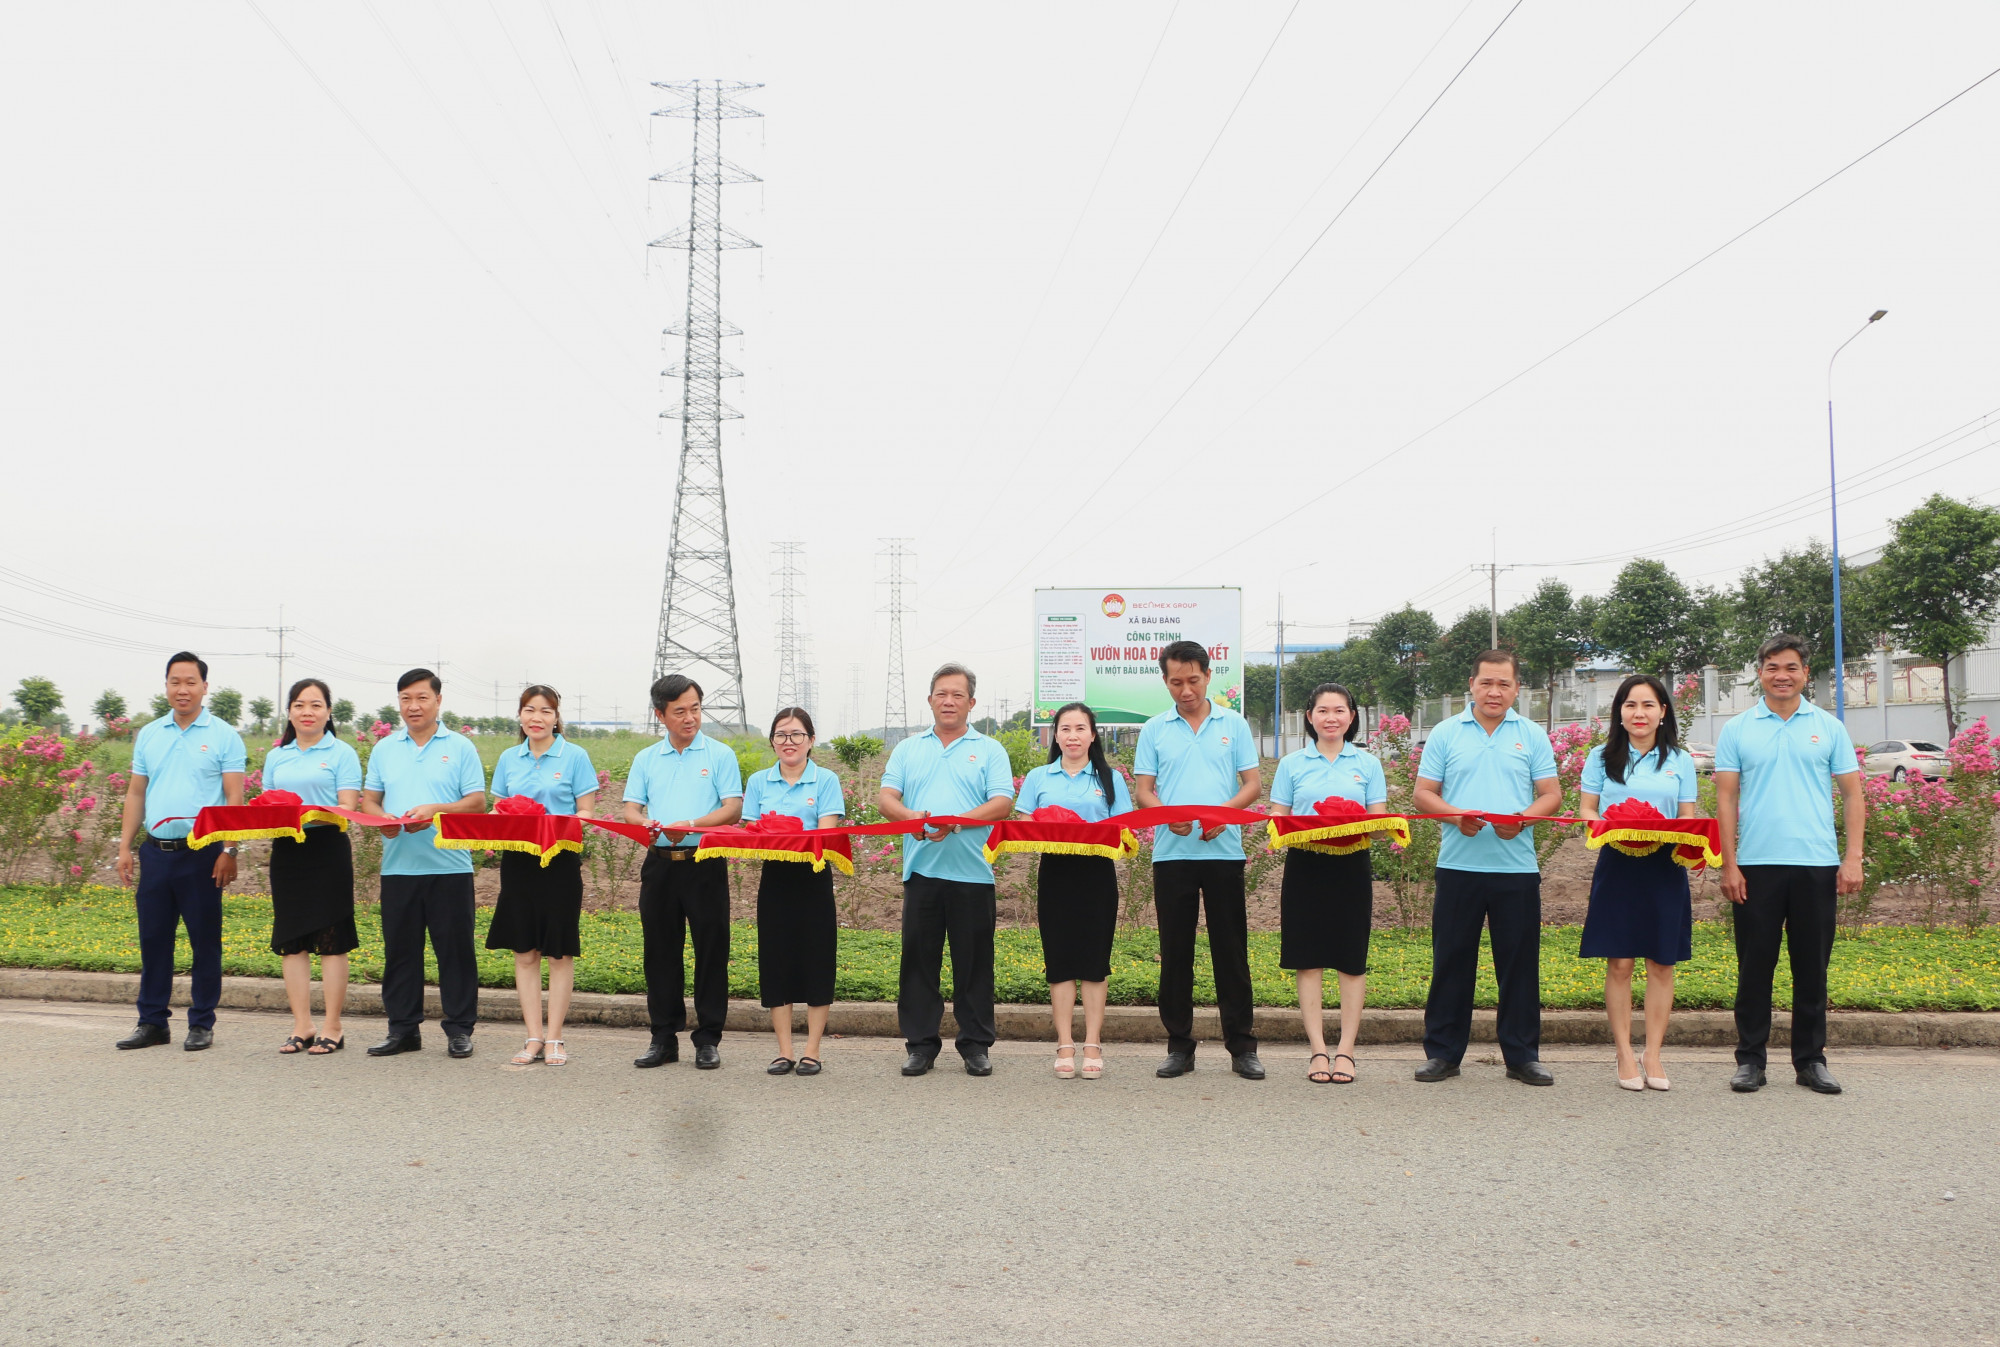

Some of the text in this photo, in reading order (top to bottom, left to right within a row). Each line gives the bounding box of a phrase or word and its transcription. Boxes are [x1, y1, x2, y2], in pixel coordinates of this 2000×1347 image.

[1128, 616, 1181, 624] XÃ BÀU BÀNG
[1126, 631, 1181, 641] CÔNG TRÌNH
[1090, 643, 1120, 660] VƯỜN
[1123, 646, 1147, 660] HOA
[1208, 642, 1229, 660] KẾT
[1095, 664, 1103, 675] VÌ
[1105, 664, 1121, 676] MỘT
[1122, 664, 1138, 675] BÀU
[1139, 664, 1160, 675] BÀNG
[1215, 666, 1229, 676] ĐẸP
